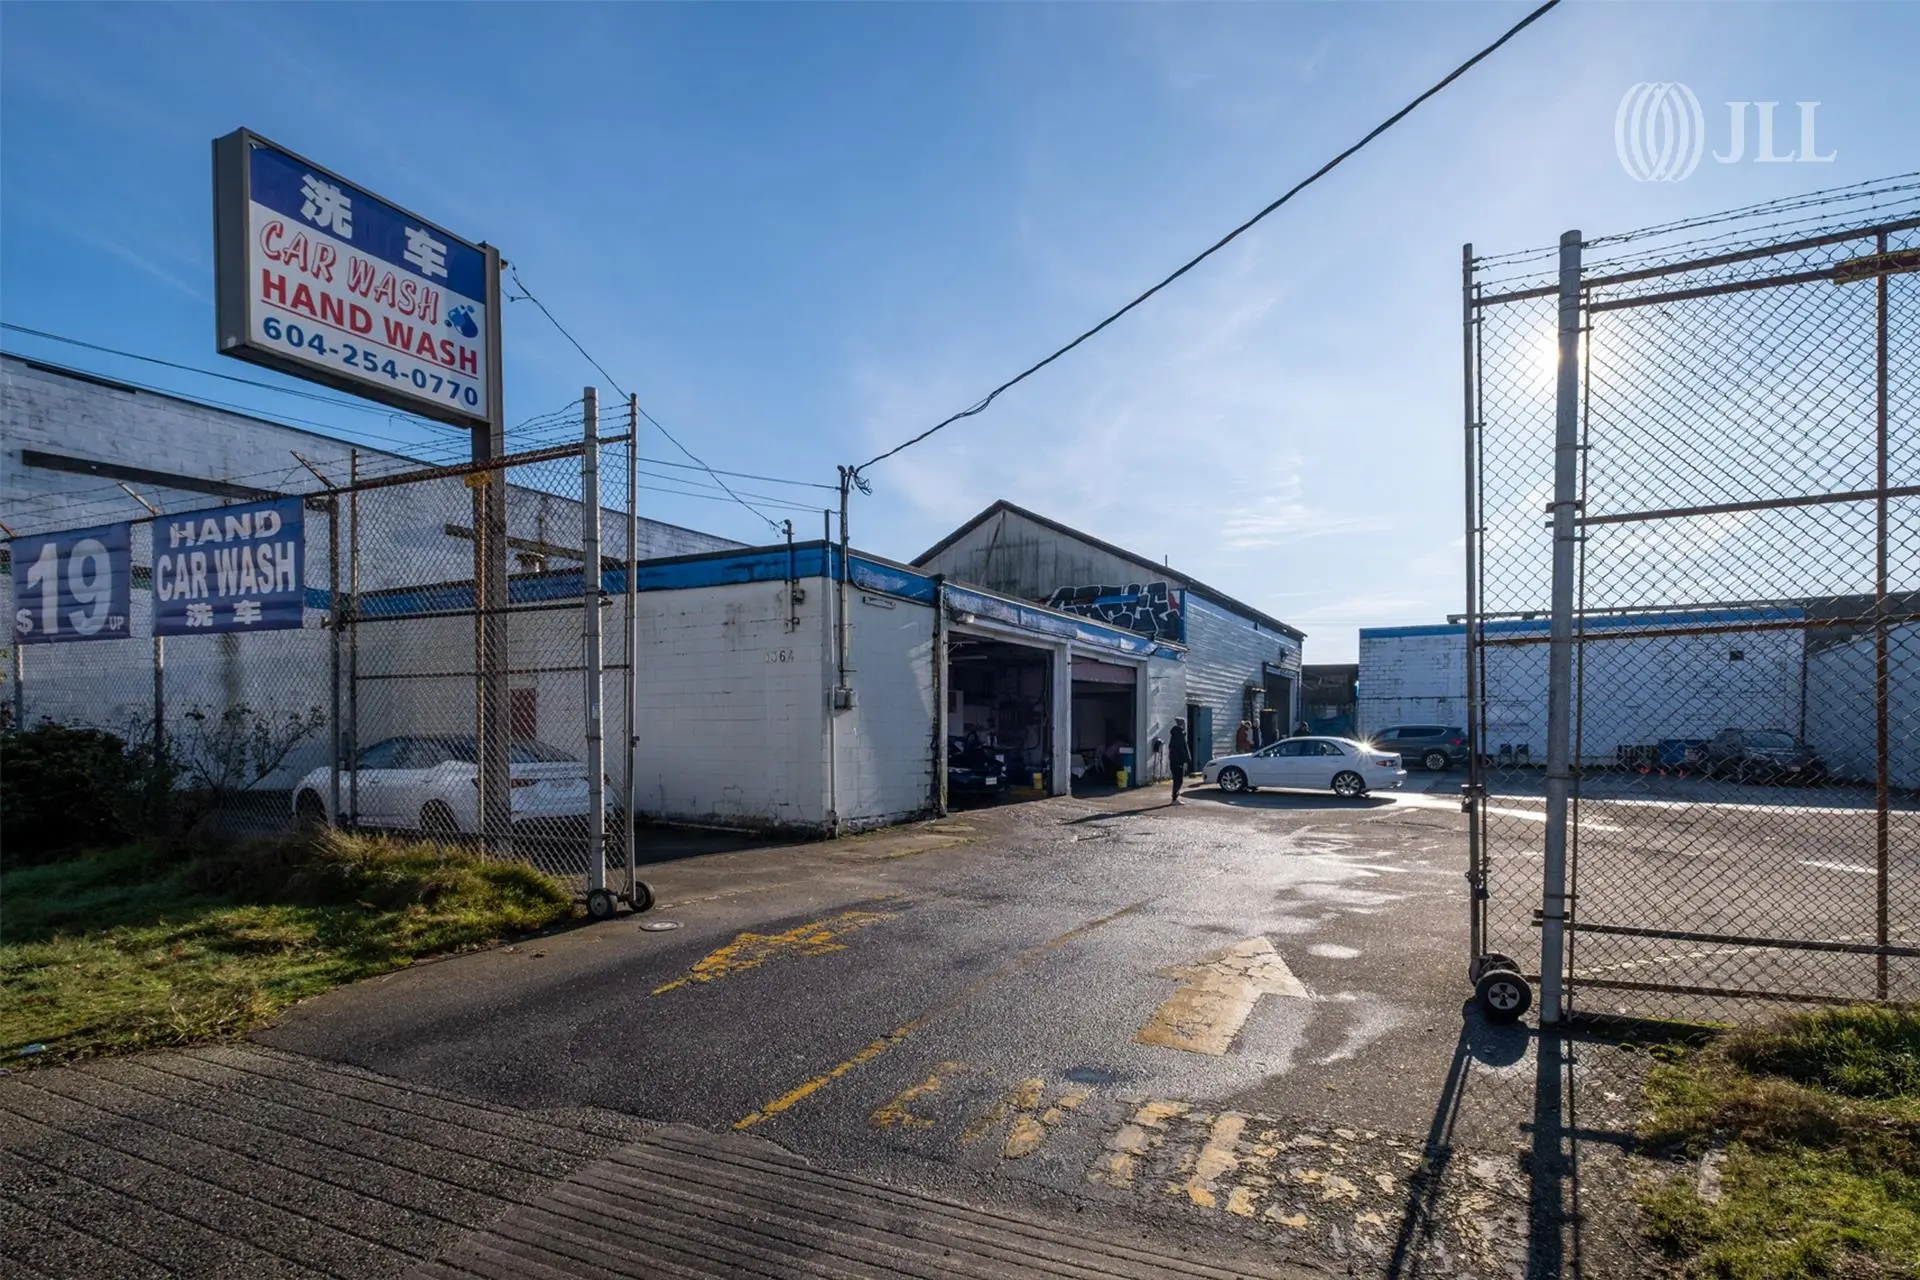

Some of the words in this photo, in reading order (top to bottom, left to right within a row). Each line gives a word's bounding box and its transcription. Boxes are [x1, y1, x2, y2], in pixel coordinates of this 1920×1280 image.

[300, 174, 448, 279] 洗车
[260, 220, 336, 283] CAR
[347, 256, 439, 325] WASH
[262, 268, 373, 334] HAND
[383, 316, 478, 375] WASH
[262, 316, 478, 406] 604-254-0770
[170, 510, 282, 548] HAND
[157, 551, 208, 601] CAR
[214, 541, 296, 597] WASH
[109, 615, 124, 631] UP
[185, 600, 262, 627] 洗车
